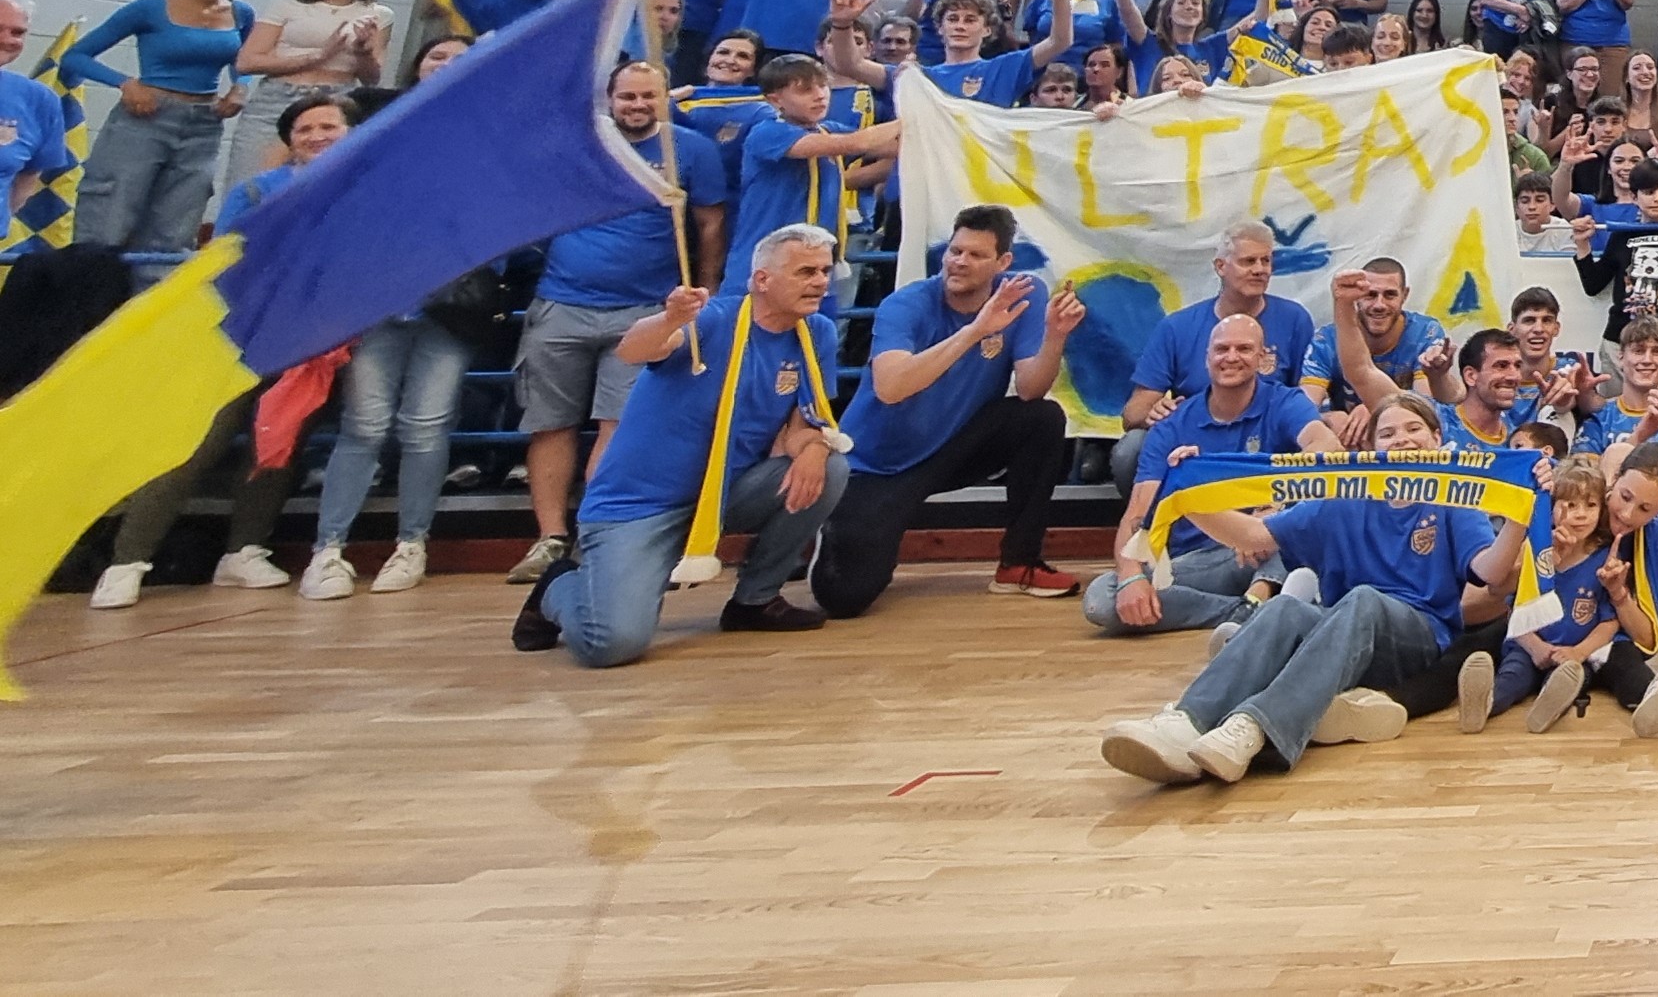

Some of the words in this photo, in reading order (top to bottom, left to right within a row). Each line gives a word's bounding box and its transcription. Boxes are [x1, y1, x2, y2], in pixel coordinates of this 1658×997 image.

[955, 56, 1497, 231] ULTRAS
[1270, 453, 1317, 468] SMO
[1323, 451, 1350, 465] MI
[1457, 451, 1497, 470] MI?
[1271, 477, 1327, 502] SMO
[1384, 476, 1439, 503] SMO
[1446, 479, 1486, 506] MI!
